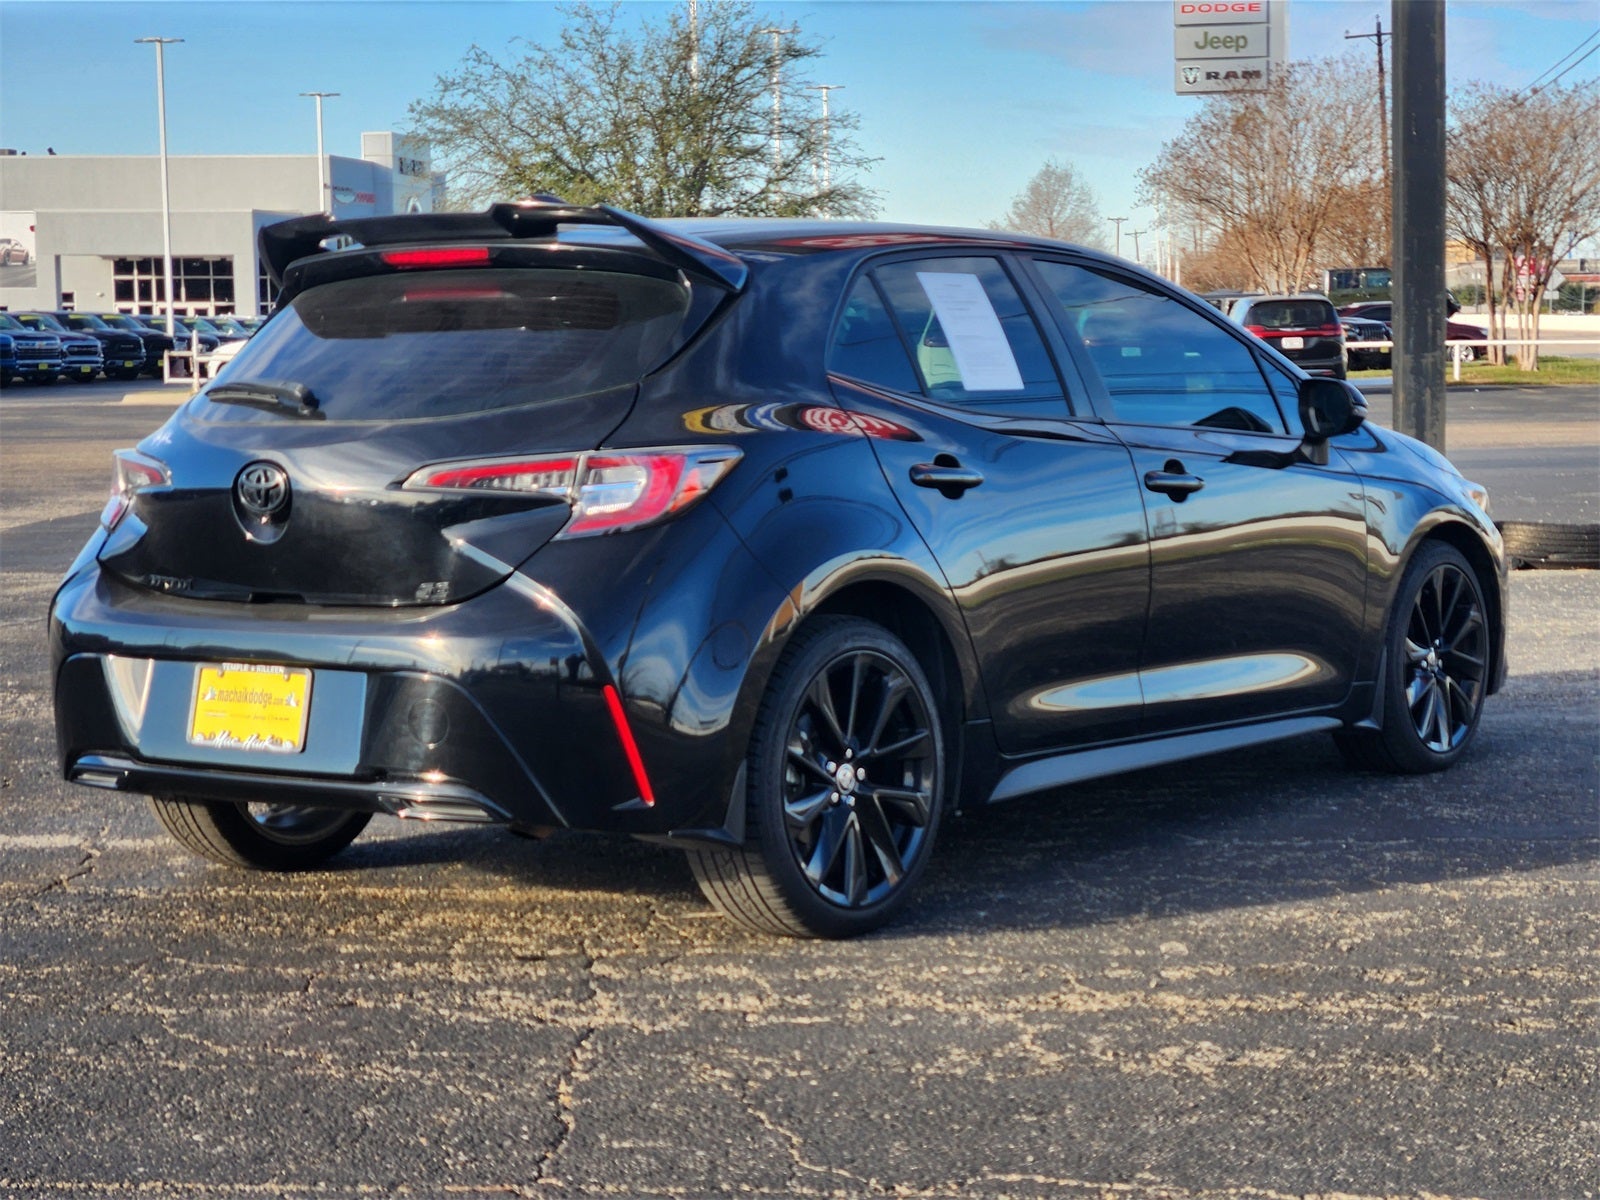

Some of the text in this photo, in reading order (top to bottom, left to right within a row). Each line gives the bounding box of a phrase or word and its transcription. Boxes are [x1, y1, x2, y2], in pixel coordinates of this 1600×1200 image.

[1181, 3, 1262, 13] DODGE
[1194, 31, 1248, 52] Jeep
[1205, 70, 1262, 80] RAM
